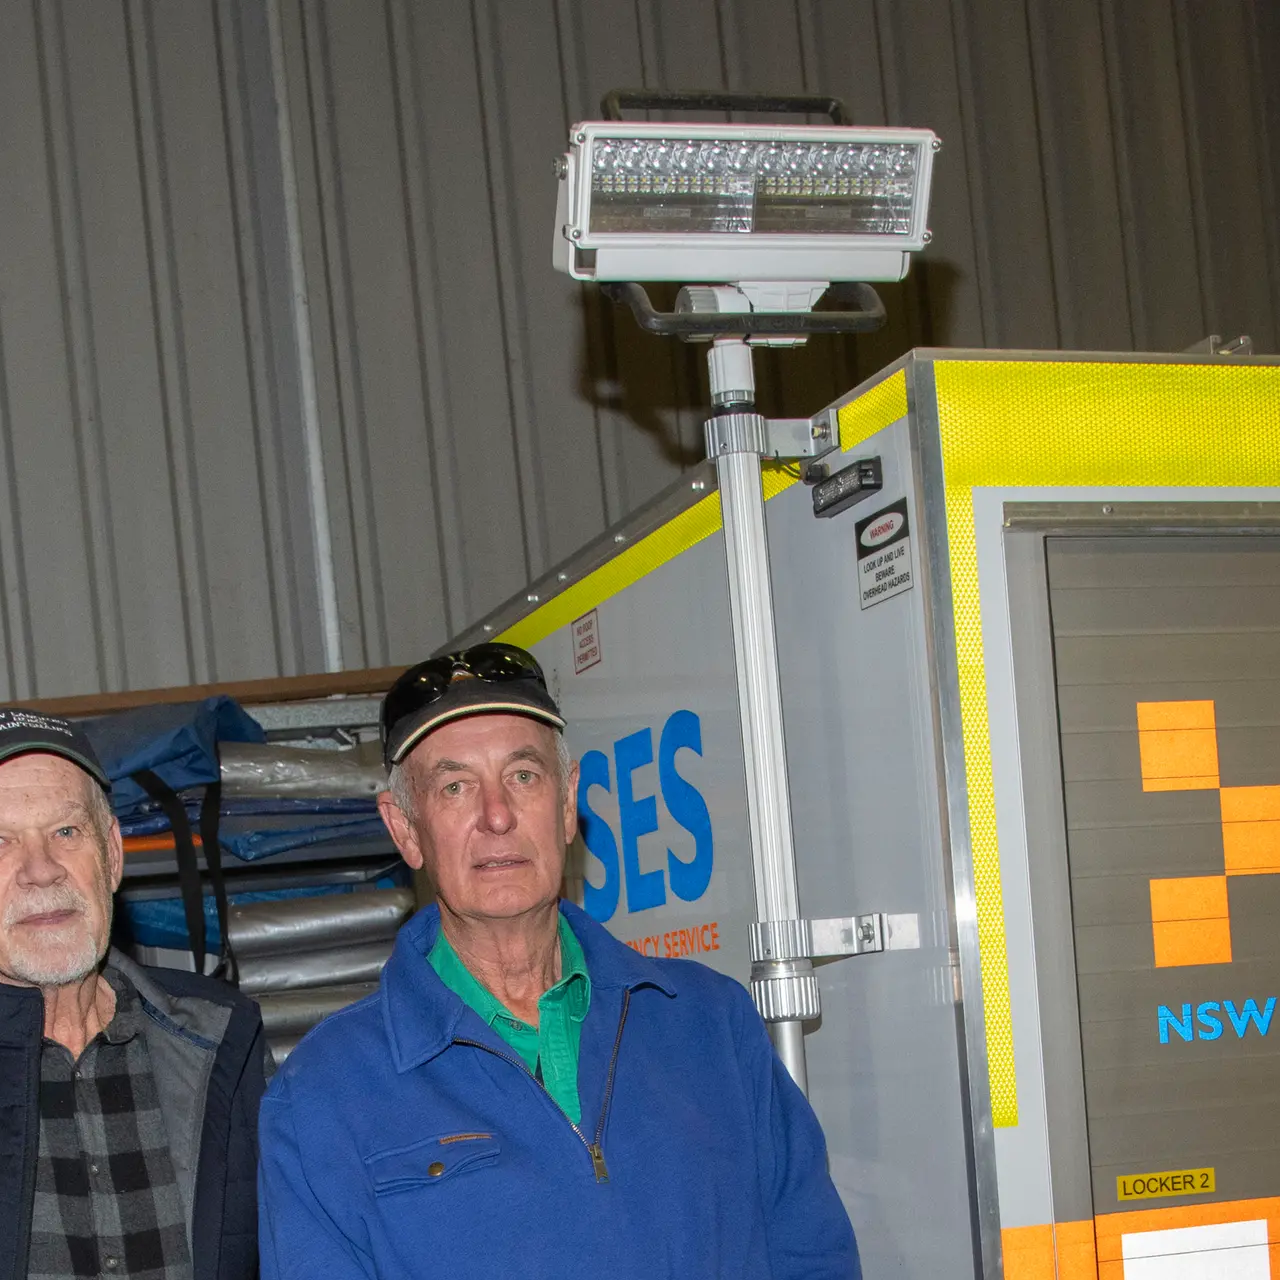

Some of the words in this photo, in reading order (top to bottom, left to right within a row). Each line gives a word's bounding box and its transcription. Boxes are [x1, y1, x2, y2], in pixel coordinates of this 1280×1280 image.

[869, 519, 895, 541] WARNING
[863, 559, 877, 574] LOOK
[877, 556, 885, 568] UP
[884, 551, 894, 564] AND
[894, 545, 905, 560] LIVE
[875, 564, 896, 583] BEWARE
[862, 581, 888, 601] OVERHEAD
[888, 571, 911, 591] HAZARDS
[578, 709, 714, 925] SES
[663, 922, 720, 959] SERVICE
[1157, 996, 1277, 1043] NSW
[1122, 1174, 1196, 1196] LOCKER
[1200, 1172, 1210, 1189] 2
